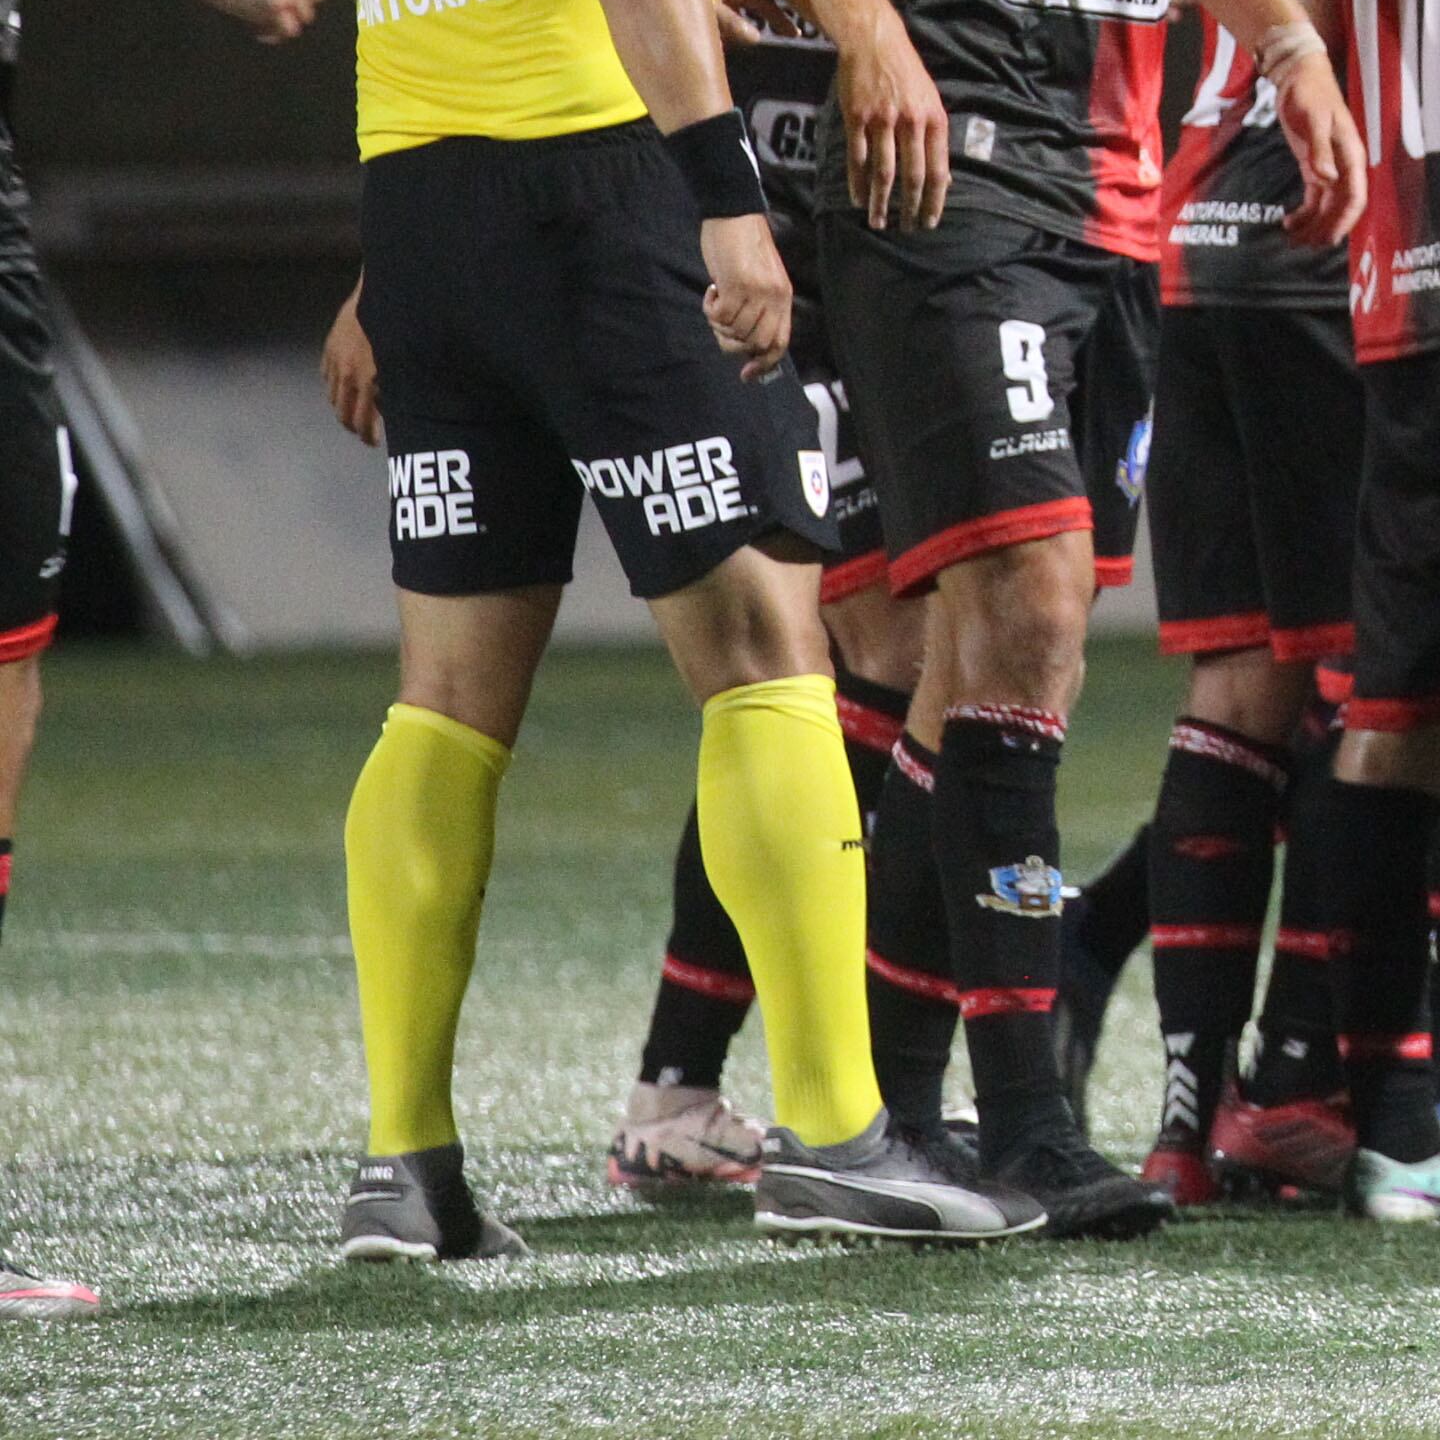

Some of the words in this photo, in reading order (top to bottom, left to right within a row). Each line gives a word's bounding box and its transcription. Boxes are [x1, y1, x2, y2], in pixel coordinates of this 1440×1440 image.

[1000, 319, 1055, 423] 9
[388, 449, 474, 499] WER
[571, 436, 740, 499] POWER
